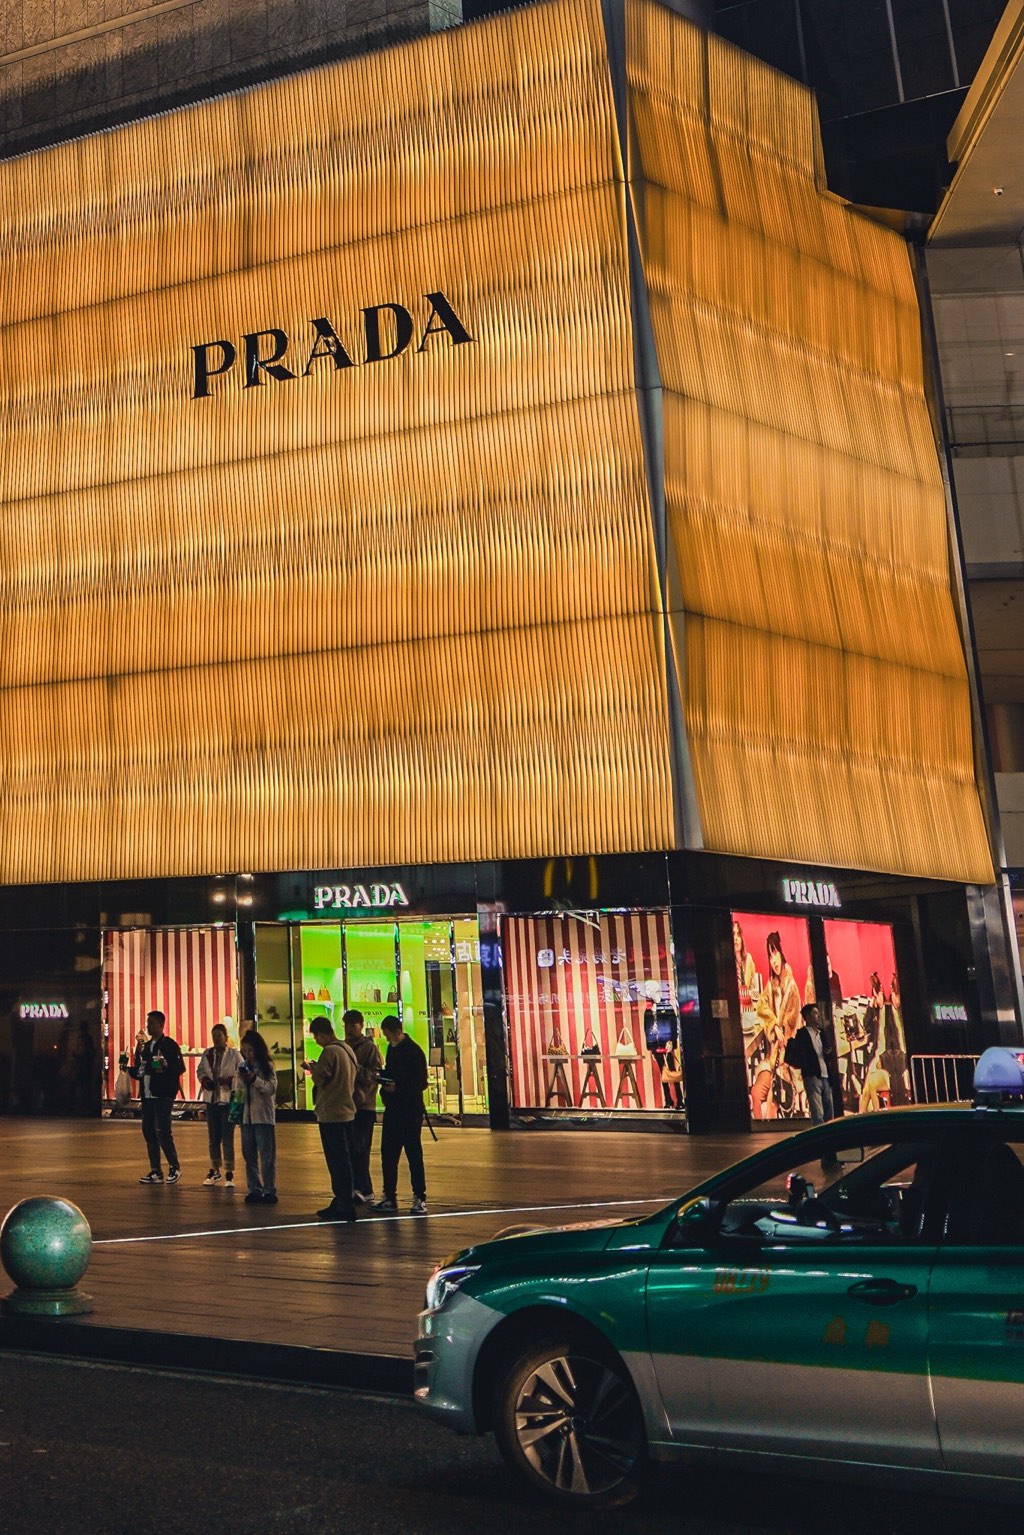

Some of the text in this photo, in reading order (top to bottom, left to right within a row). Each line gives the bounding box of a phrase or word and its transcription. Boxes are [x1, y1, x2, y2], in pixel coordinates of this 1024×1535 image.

[190, 291, 478, 400] PRADA
[314, 883, 409, 909] PRADA
[782, 878, 842, 907] PRADA
[19, 1003, 69, 1018] PRADA
